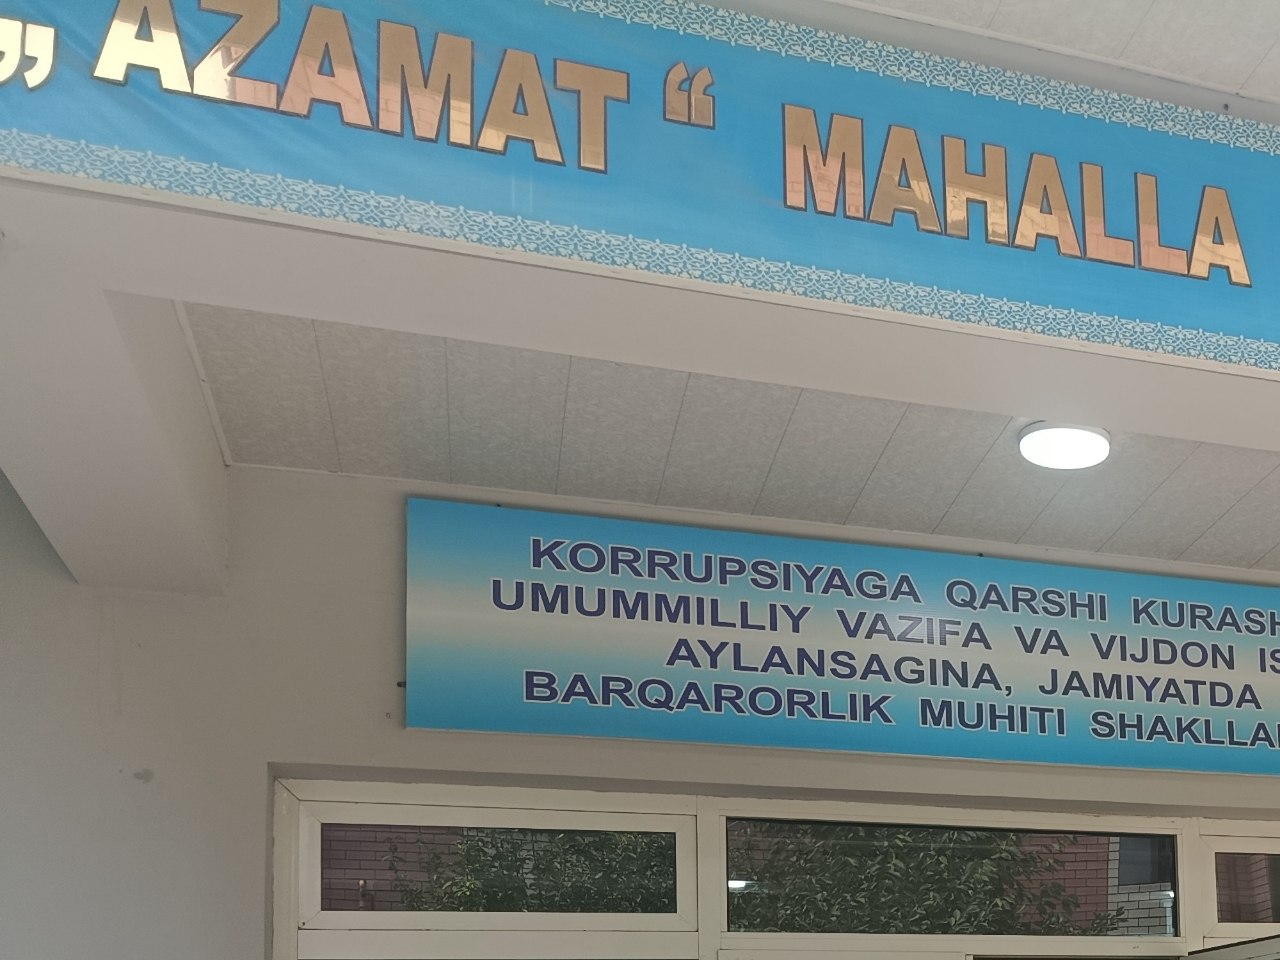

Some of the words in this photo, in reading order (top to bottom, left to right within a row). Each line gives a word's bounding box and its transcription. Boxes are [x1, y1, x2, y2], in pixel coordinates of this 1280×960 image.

[782, 103, 1252, 287] MAHALLA
[530, 537, 922, 604] KORRUPSIYAGA
[945, 579, 1108, 621] QARSHI
[491, 578, 812, 634] UMUMMILLIY
[836, 609, 993, 650] VAZIFA
[1013, 625, 1070, 657] VA
[1090, 632, 1235, 671] VIJDON
[524, 670, 895, 724] BARQARORLIK
[919, 697, 1066, 736] MUHITI
[665, 638, 1013, 697] AYLANSAGINA,
[1038, 668, 1263, 710] JAMIYATDA
